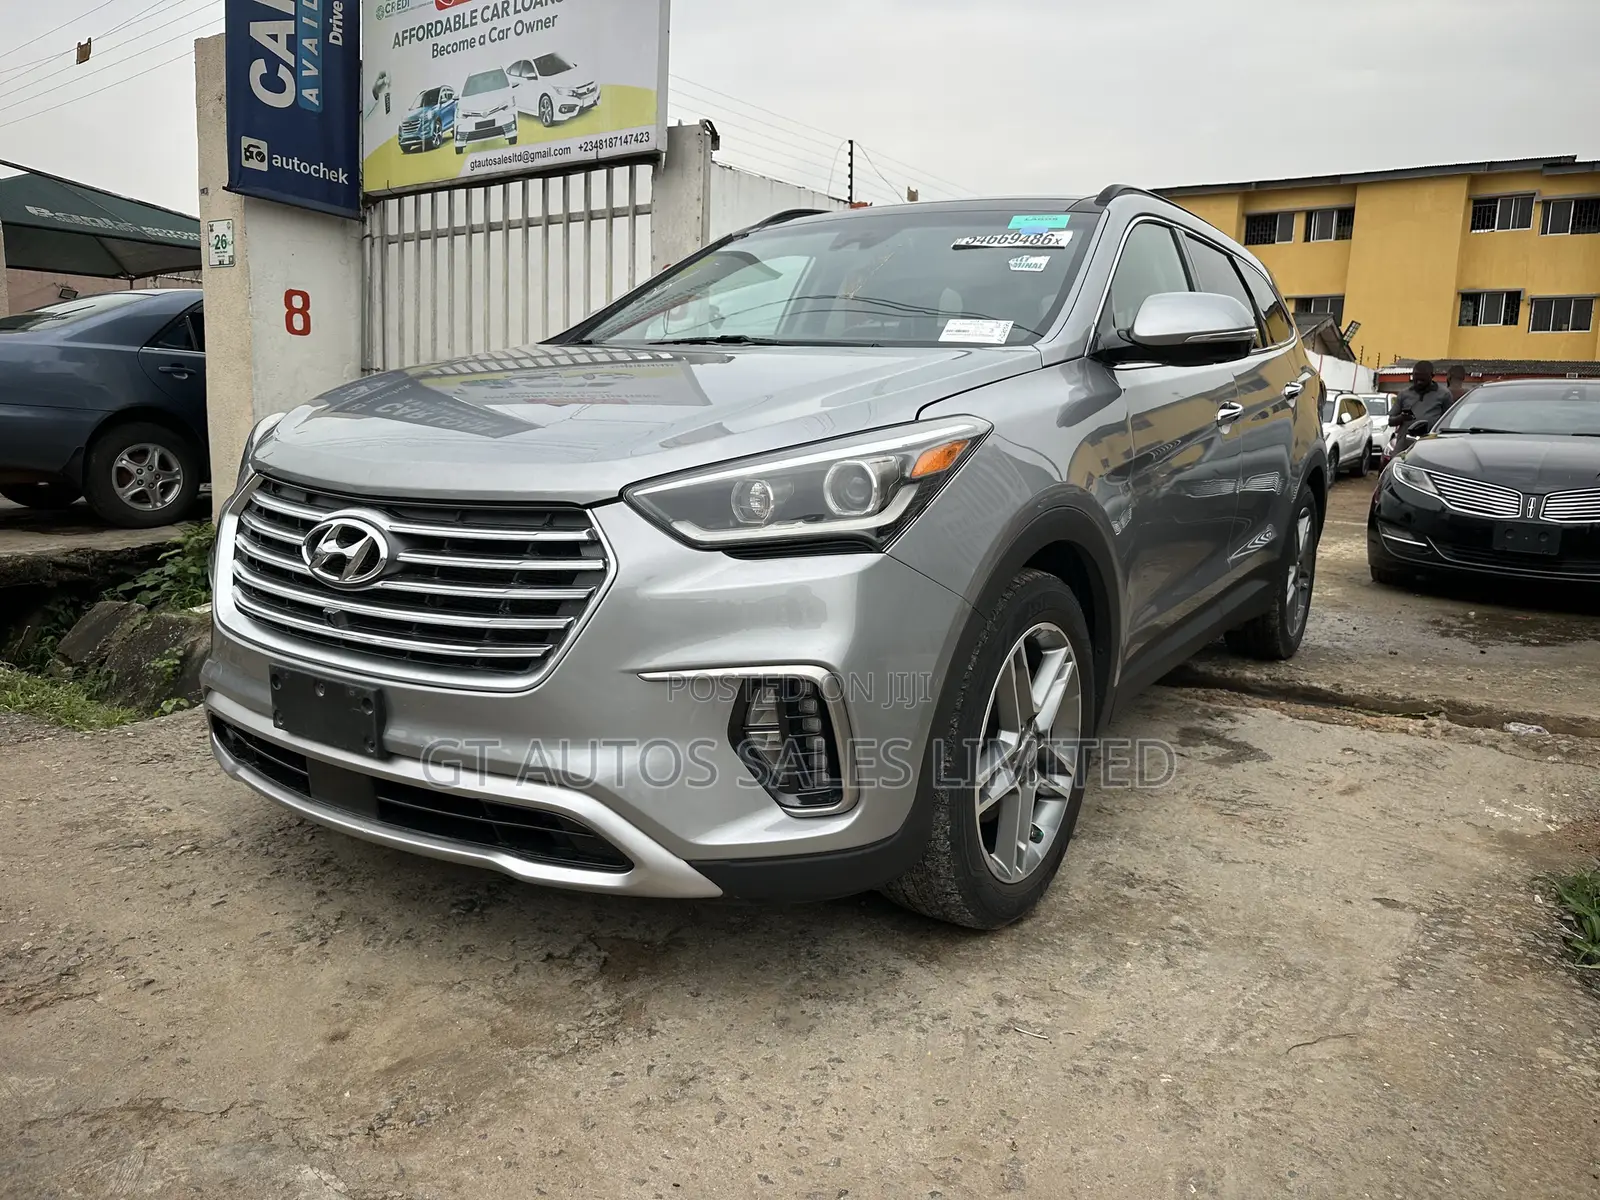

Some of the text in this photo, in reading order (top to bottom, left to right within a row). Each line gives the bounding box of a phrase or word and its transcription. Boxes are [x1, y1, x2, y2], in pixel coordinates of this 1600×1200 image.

[329, 0, 344, 46] Drive
[392, 9, 478, 49] AFFORDABLE
[480, 2, 510, 24] CAR
[431, 14, 559, 59] Become a Car Owner
[249, 0, 295, 108] CA
[271, 154, 349, 185] autochek
[469, 131, 650, 172] gtautosalesltd@gmail.com +2348187147423
[214, 233, 228, 250] 26
[284, 288, 312, 336] 8
